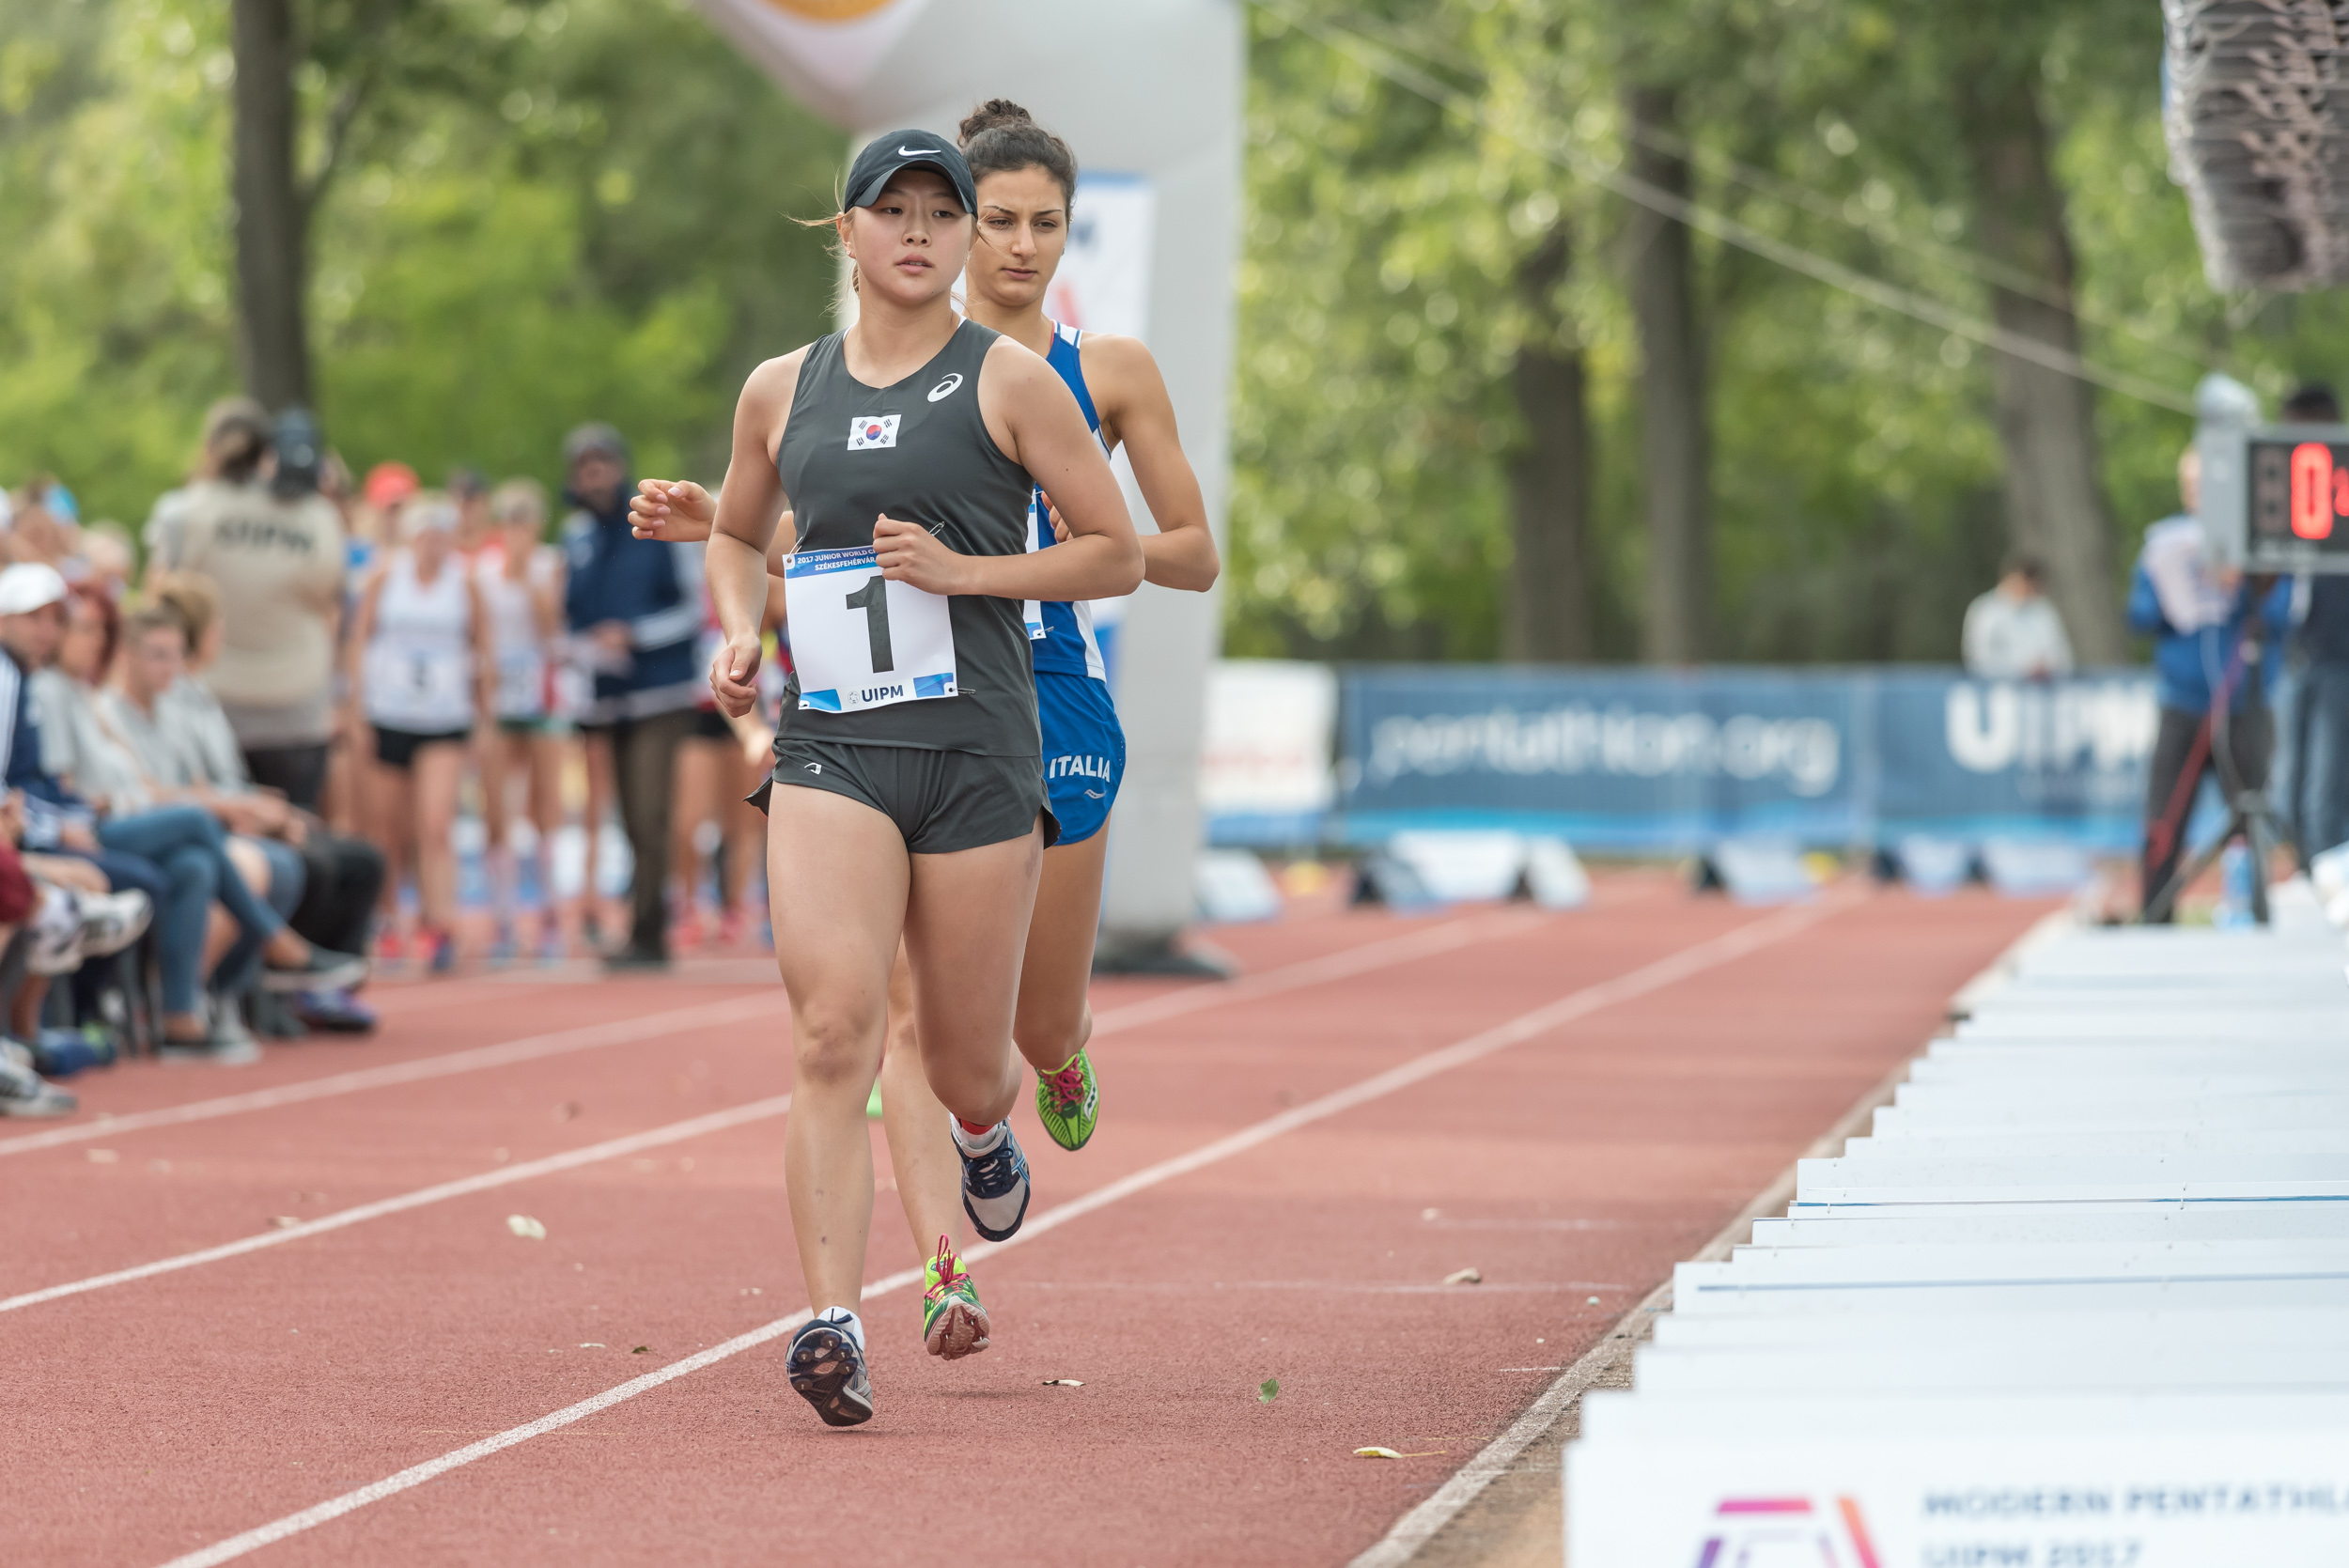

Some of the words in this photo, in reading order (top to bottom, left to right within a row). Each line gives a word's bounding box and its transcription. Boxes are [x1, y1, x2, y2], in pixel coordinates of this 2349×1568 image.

[815, 553, 841, 562] JUNIOR
[815, 556, 876, 570] SZÉKESFEHÉRVÁR
[846, 575, 894, 673] 1
[862, 685, 904, 703] UIPM
[1945, 682, 2160, 772] UIPM
[1369, 705, 1840, 797] pentathlon.org
[1050, 755, 1110, 783] ITALIA
[1923, 1486, 2110, 1517] MODERN
[2125, 1483, 2349, 1515] PENTATHL
